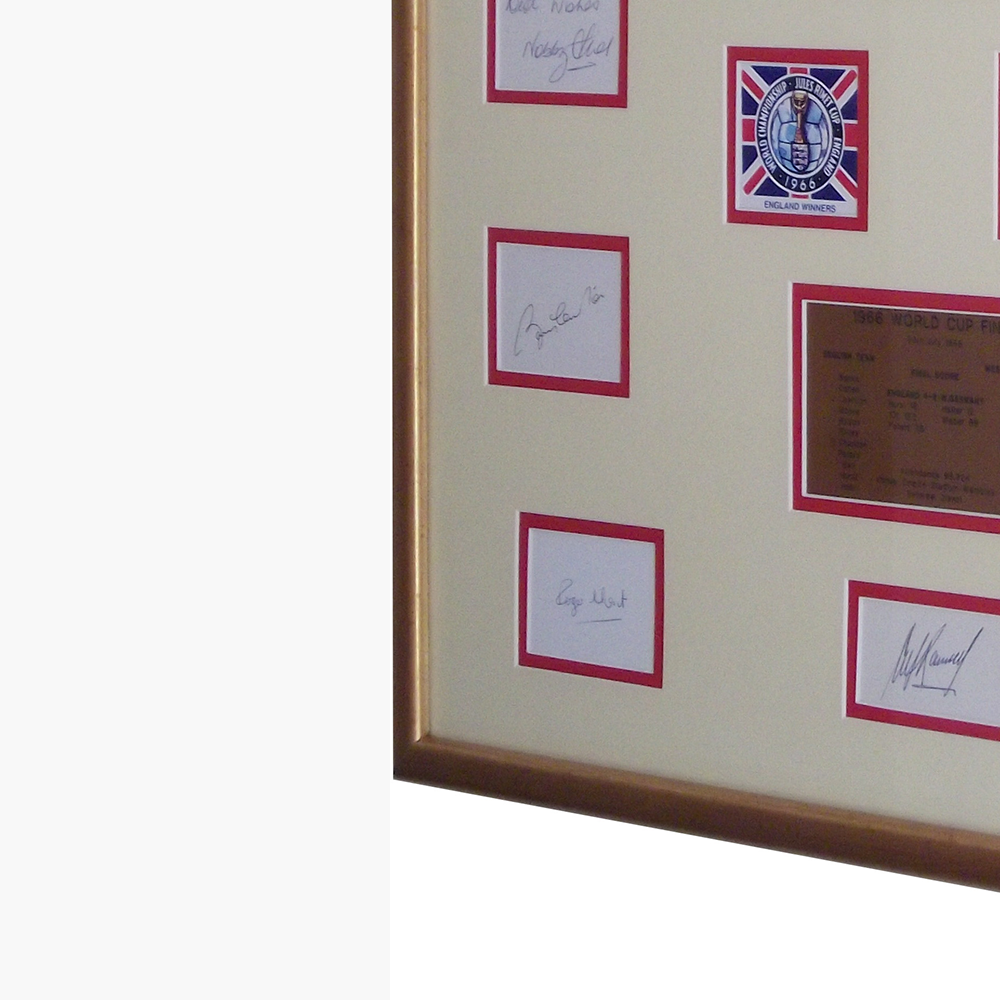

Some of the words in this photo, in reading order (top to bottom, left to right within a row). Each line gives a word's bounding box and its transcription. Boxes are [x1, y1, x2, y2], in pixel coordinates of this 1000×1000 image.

[757, 81, 787, 138] CHAMPIONSHIP
[795, 77, 815, 91] JULES
[814, 83, 832, 107] RIMET
[829, 106, 840, 125] CUP
[758, 139, 777, 174] WORLD
[823, 137, 842, 177] ENGLAND
[785, 176, 816, 191] 1966
[764, 200, 799, 211] ENGLAND
[801, 202, 836, 213] WINNERS
[853, 310, 883, 325] 1966
[891, 312, 939, 331] WORLD
[947, 316, 973, 332] CUP
